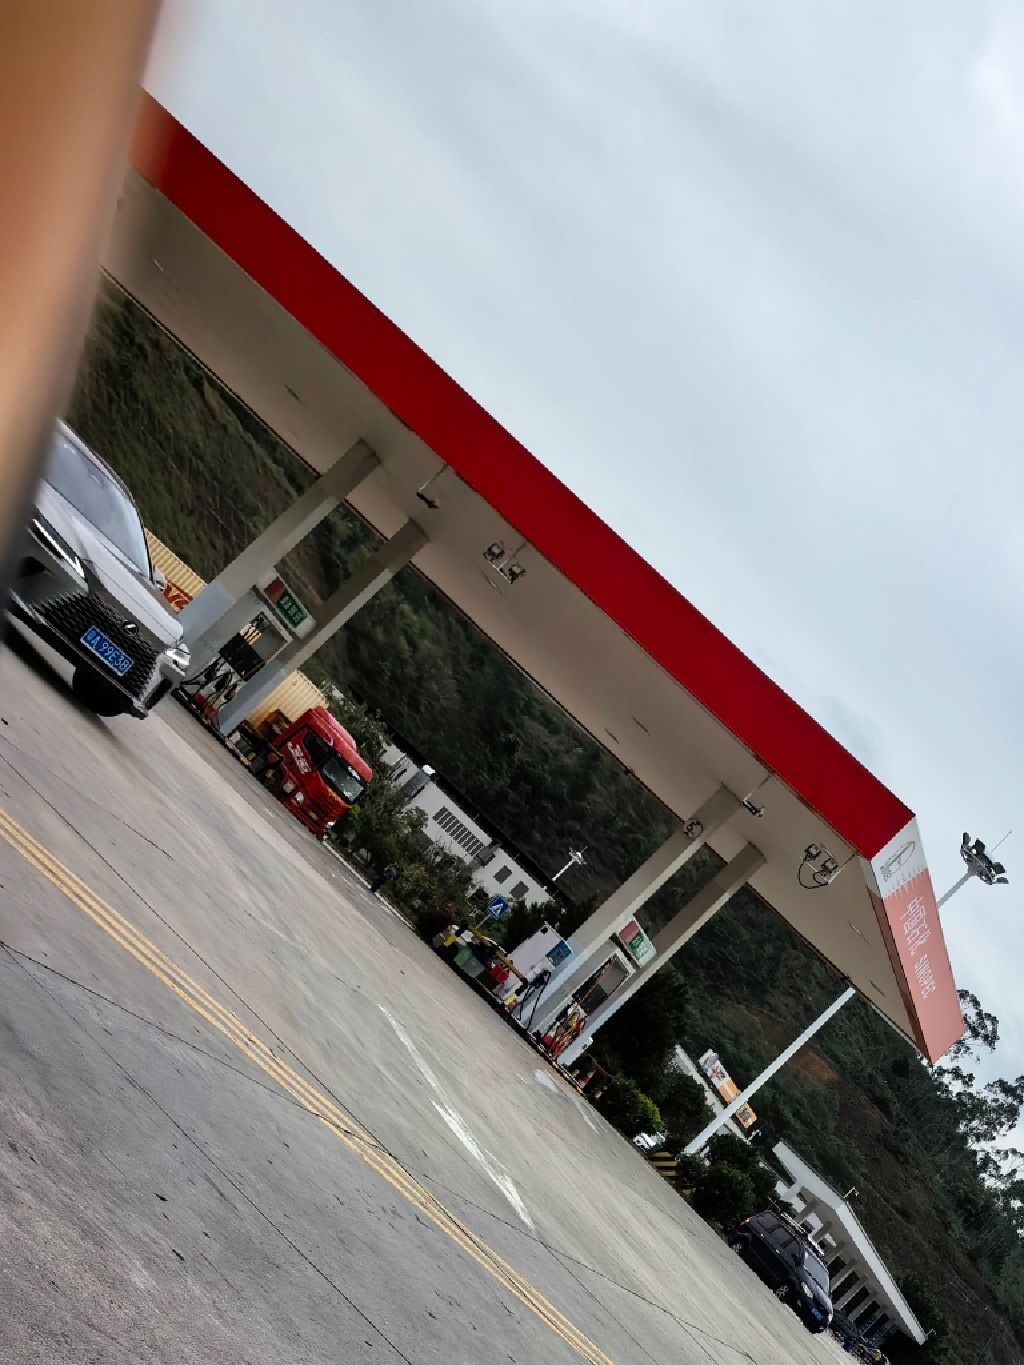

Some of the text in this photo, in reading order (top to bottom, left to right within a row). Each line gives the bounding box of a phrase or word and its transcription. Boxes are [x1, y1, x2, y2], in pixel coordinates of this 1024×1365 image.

[901, 897, 936, 999] 中国石化 SINOPEC
